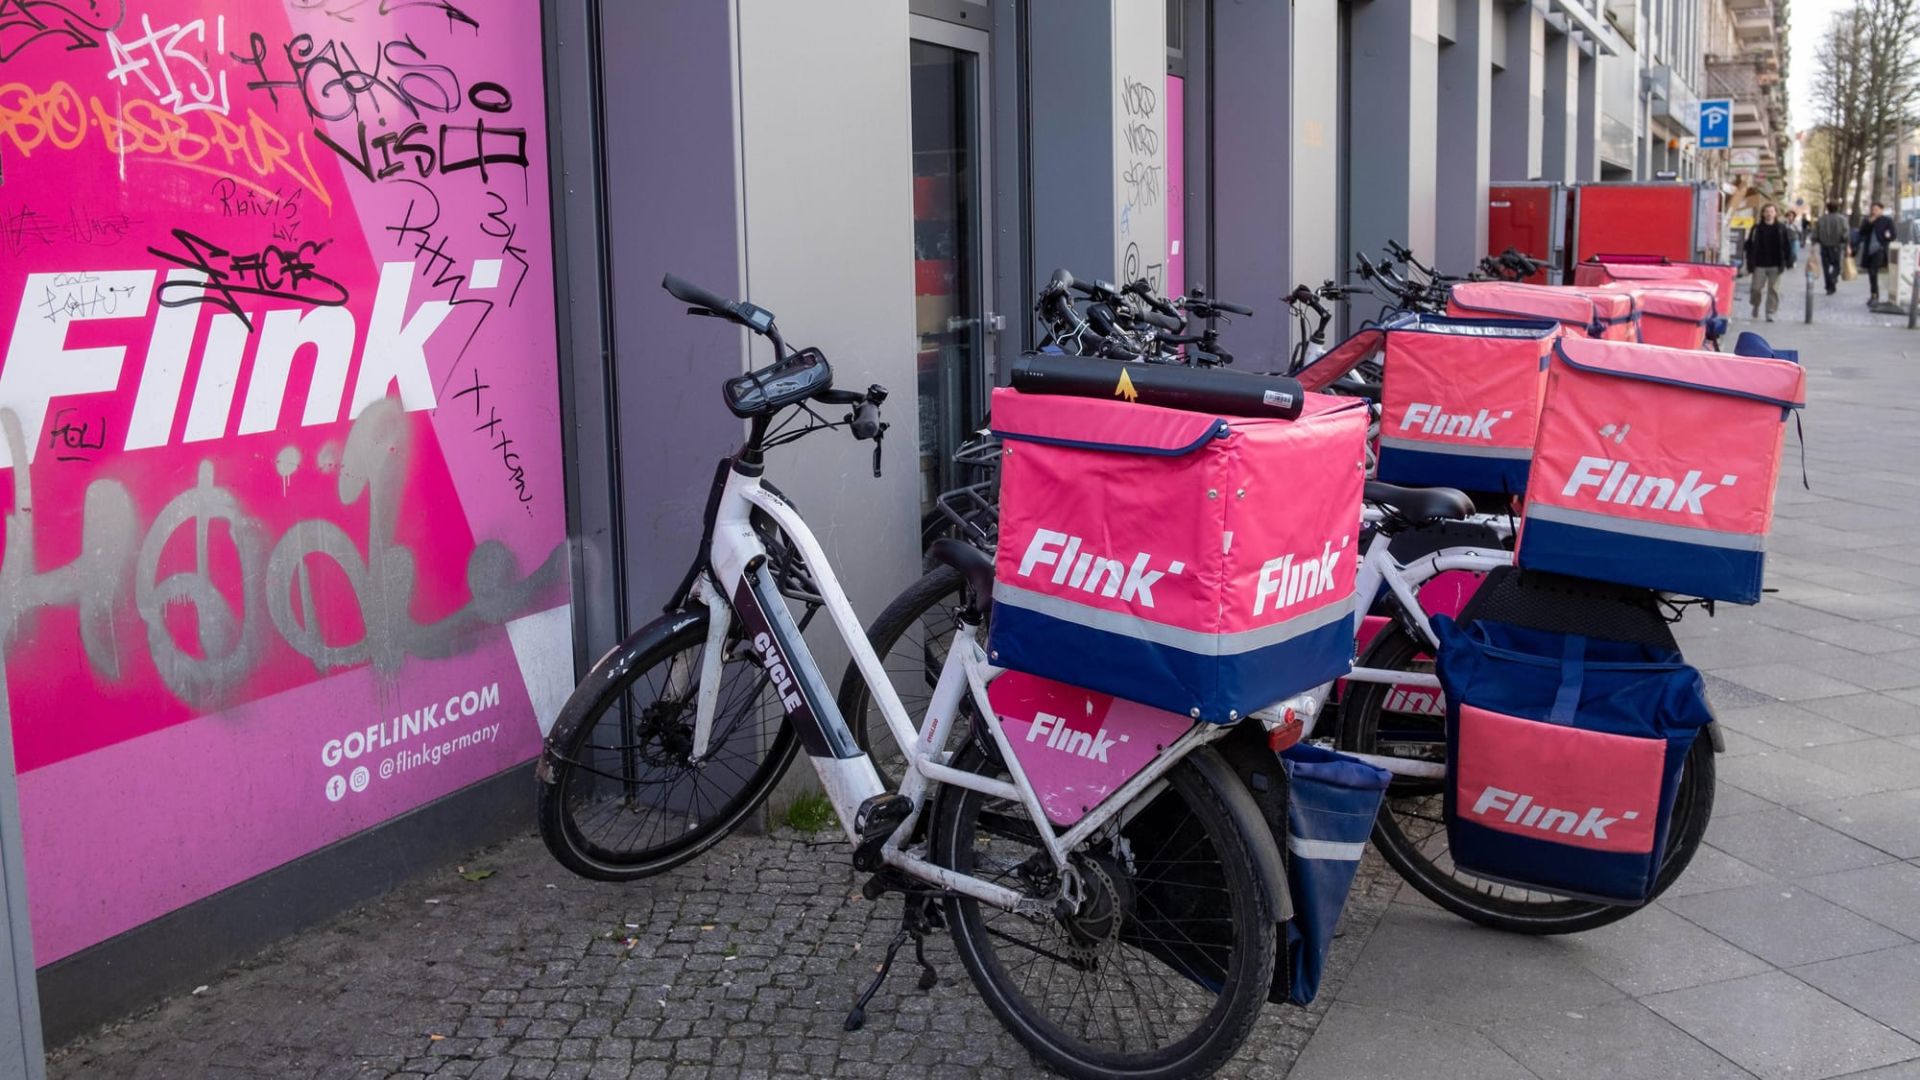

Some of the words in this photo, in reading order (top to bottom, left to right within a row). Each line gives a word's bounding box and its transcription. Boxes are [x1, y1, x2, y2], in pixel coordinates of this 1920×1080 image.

[0, 260, 502, 468] Flink
[1400, 402, 1513, 440] Flink
[1562, 455, 1738, 516] Flink
[1018, 528, 1185, 608] Flink
[1252, 535, 1350, 617] Flink
[754, 631, 803, 714] CYCLE
[321, 682, 501, 767] GOFLINK.COM
[379, 722, 500, 779] @flinkgermany
[1026, 713, 1130, 764] Flink
[1472, 786, 1640, 840] Flink
